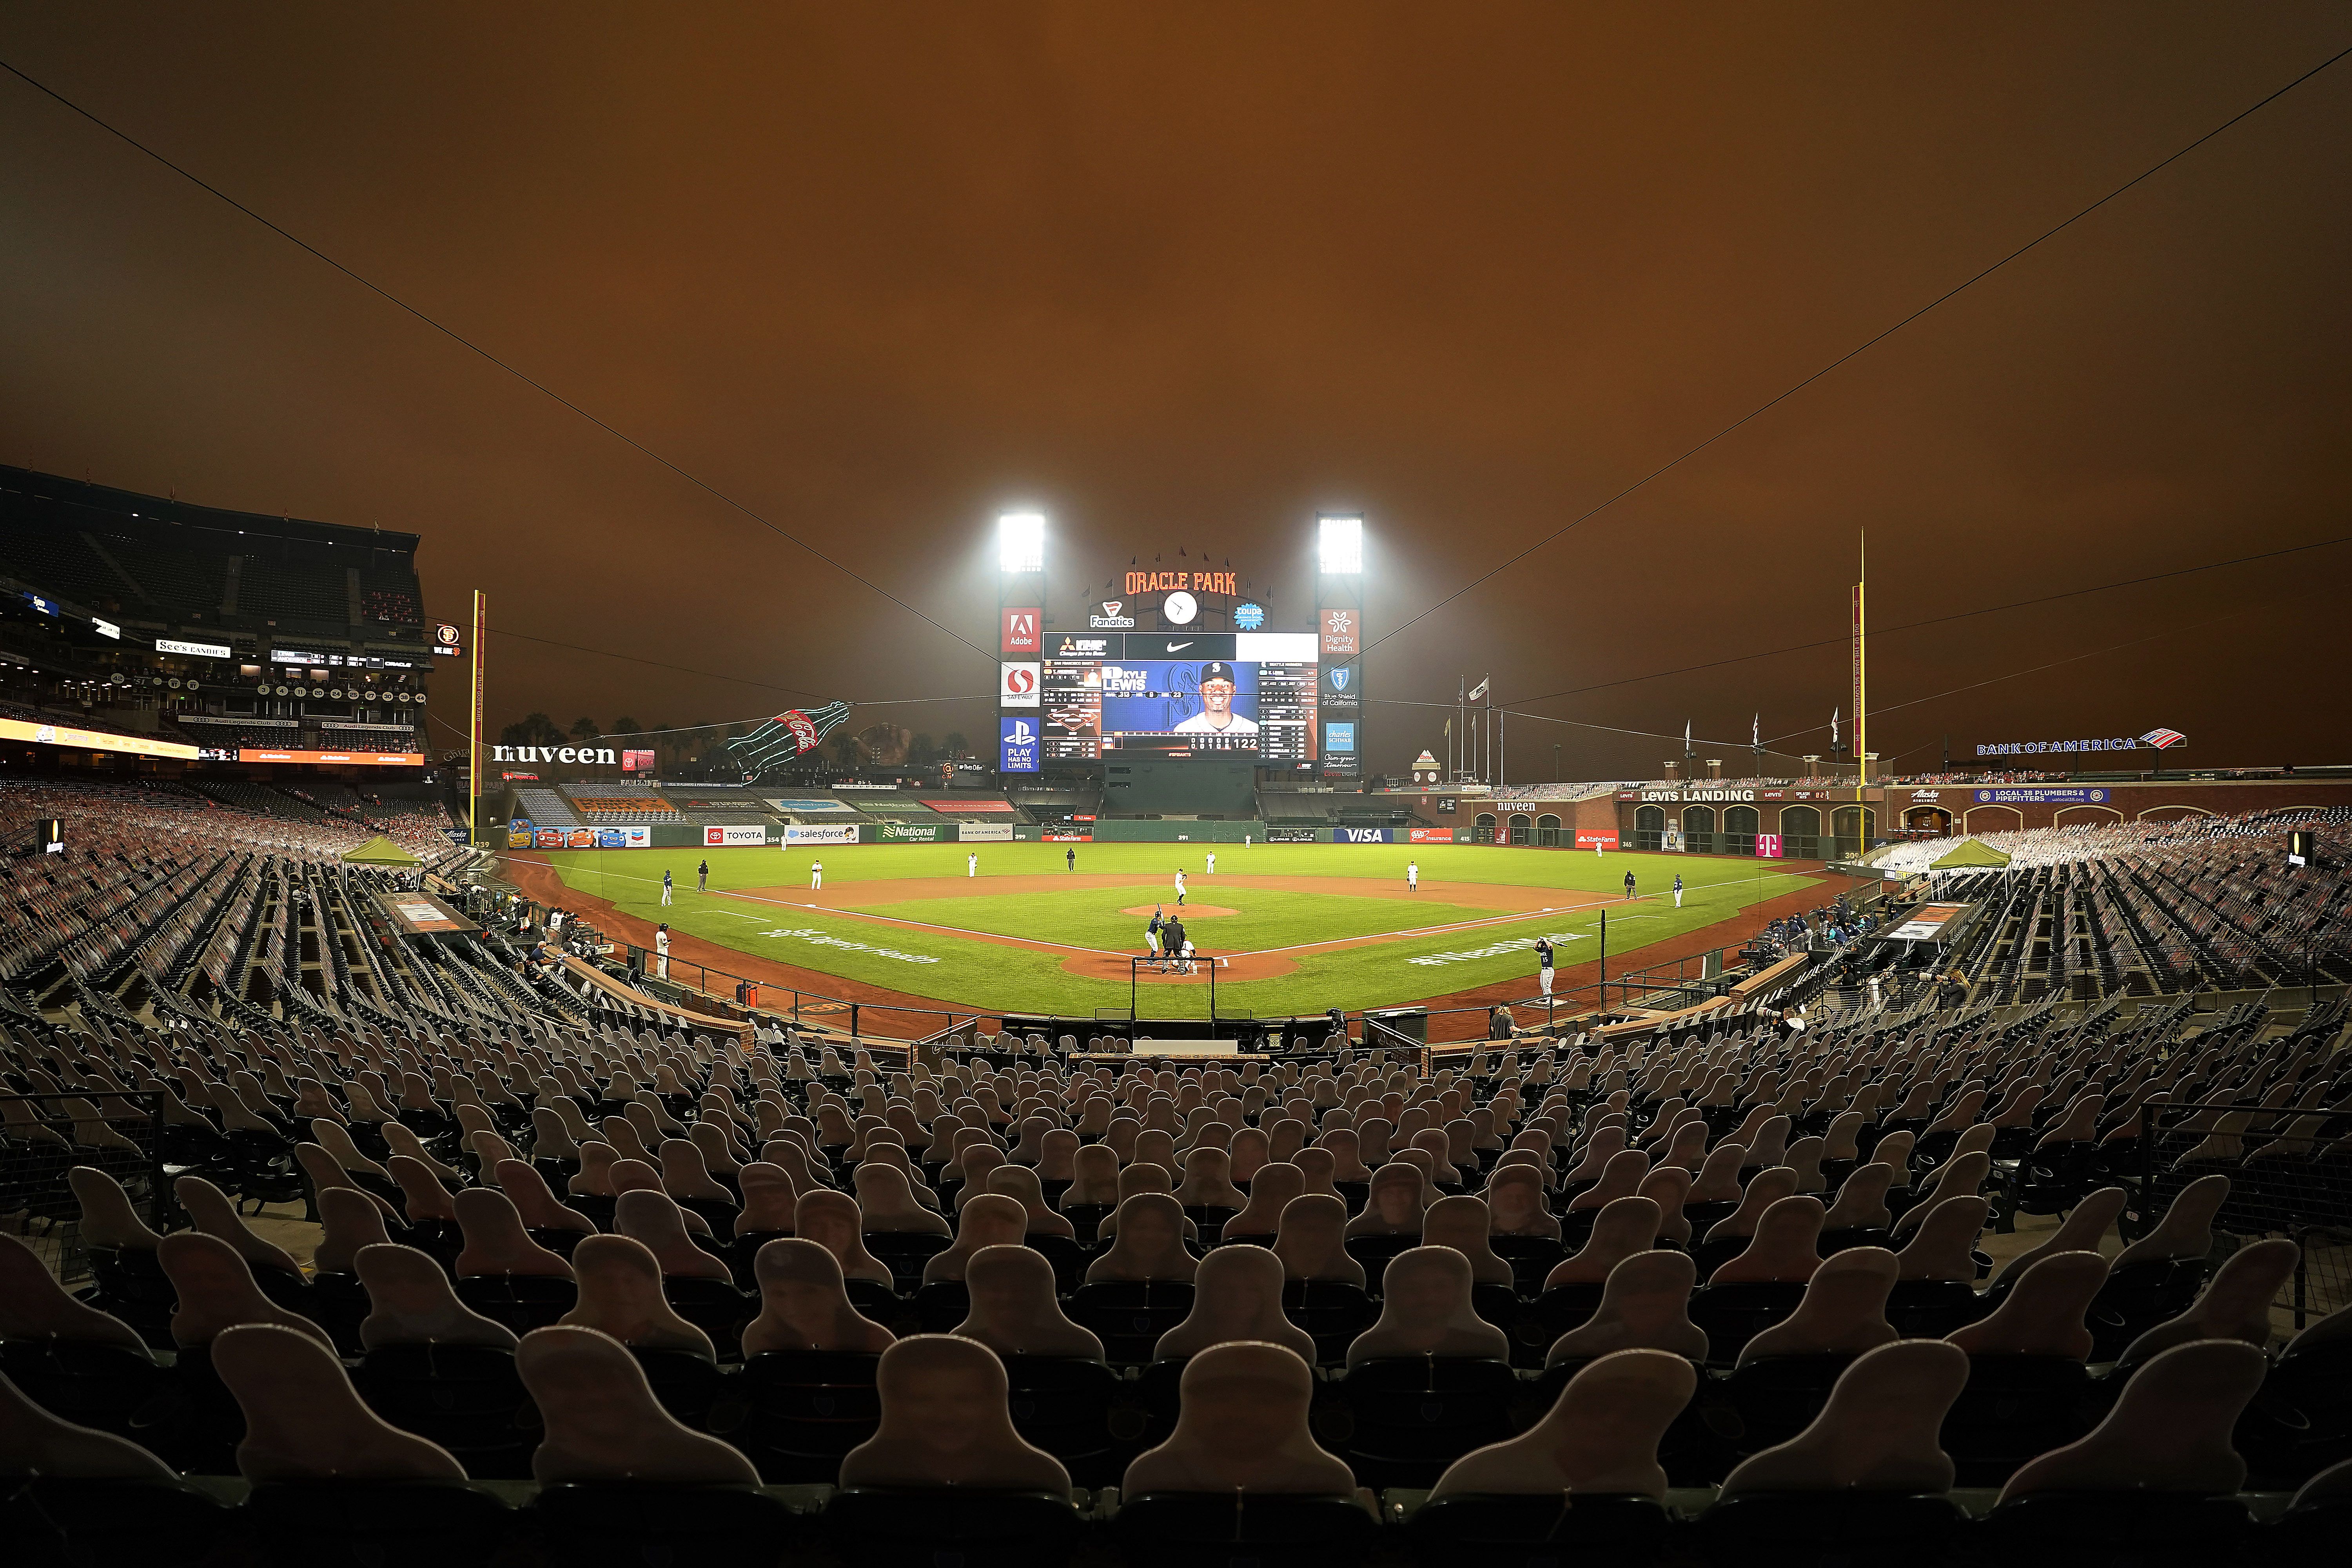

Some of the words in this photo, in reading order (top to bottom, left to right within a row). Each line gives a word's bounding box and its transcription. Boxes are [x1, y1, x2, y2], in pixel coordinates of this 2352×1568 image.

[1126, 572, 1188, 595] ORACLE
[1194, 572, 1236, 595] PARK
[1237, 608, 1262, 616] coupa
[1092, 617, 1133, 626] Fanatics
[1010, 637, 1033, 645] Adobe
[1325, 635, 1354, 644] Dignity
[160, 641, 187, 652] See's
[191, 647, 225, 655] CANDIES
[477, 668, 482, 676] 5G
[1123, 670, 1147, 679] KYLE
[1103, 679, 1146, 691] LEWIS
[1008, 748, 1032, 757] PLAY
[1977, 743, 2022, 756] BANK
[2025, 741, 2048, 754] OF
[2050, 738, 2136, 752] AMERICA
[492, 745, 616, 764] nuveen
[1683, 790, 1754, 802] LANDING
[1911, 789, 1940, 799] Alaska
[1497, 802, 1536, 811] nuveen
[800, 829, 844, 840] salesforce
[895, 826, 936, 837] National
[1344, 829, 1383, 842] VISA
[1759, 834, 1777, 857] T
[802, 936, 873, 953] Dignity
[863, 948, 942, 964] Health
